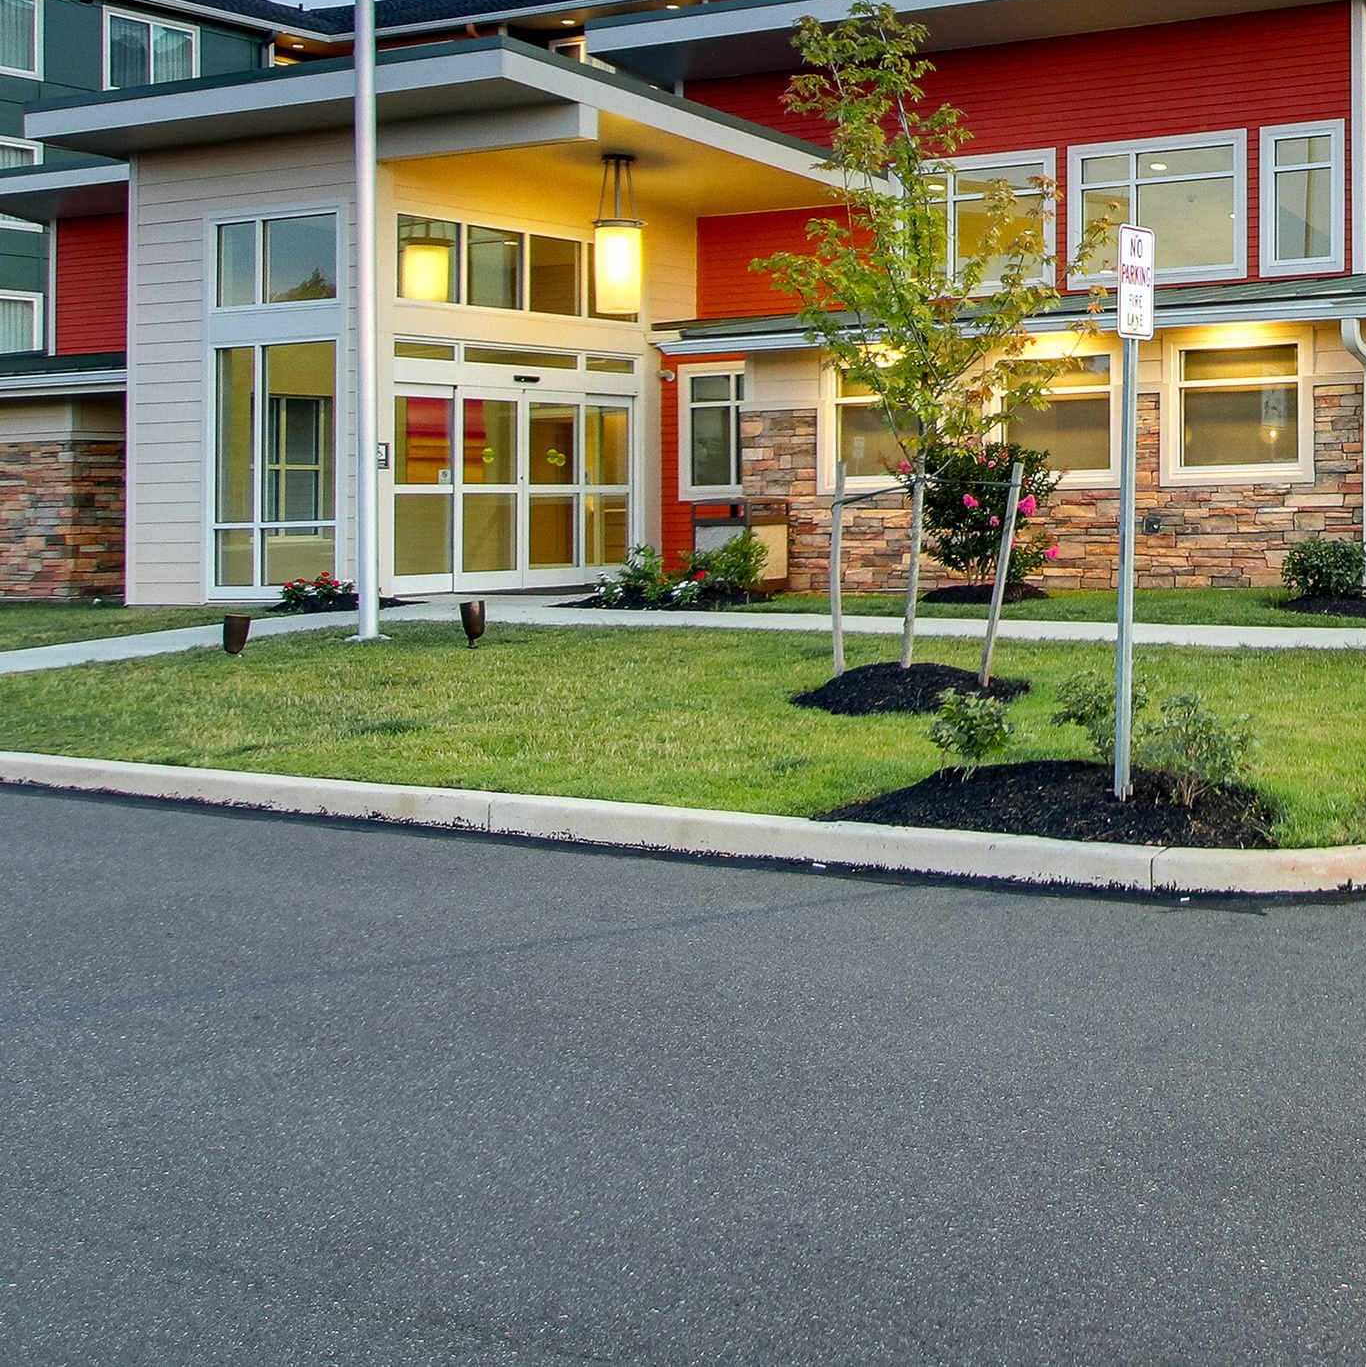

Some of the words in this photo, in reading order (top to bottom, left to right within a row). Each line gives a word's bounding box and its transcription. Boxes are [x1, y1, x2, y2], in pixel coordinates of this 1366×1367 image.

[1130, 236, 1143, 259] NO
[1121, 263, 1152, 287] PARKING
[1128, 293, 1143, 308] FIRE
[1127, 313, 1143, 327] LANE
